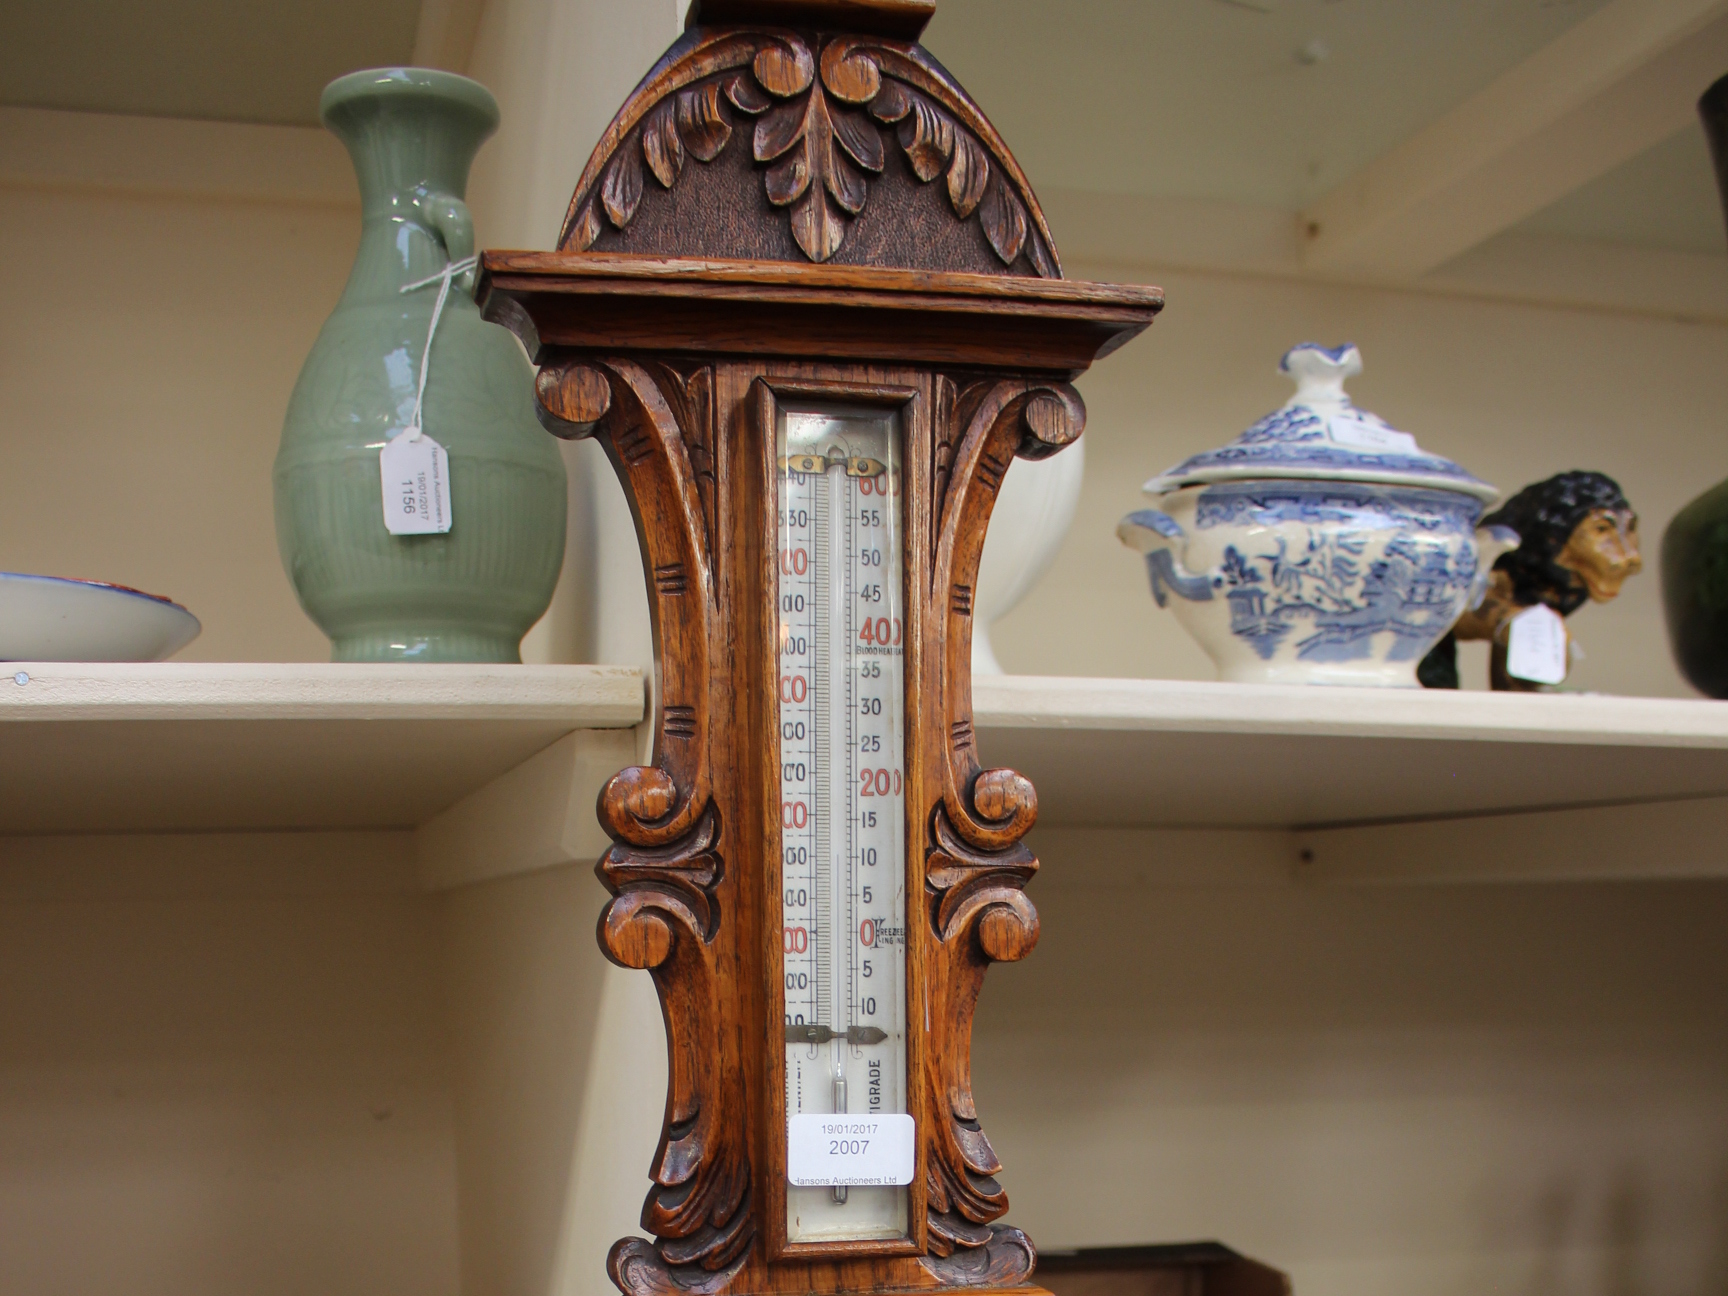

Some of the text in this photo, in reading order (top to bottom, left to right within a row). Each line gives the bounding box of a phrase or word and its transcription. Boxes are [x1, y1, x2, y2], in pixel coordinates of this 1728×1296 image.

[402, 479, 416, 514] 1156
[417, 472, 429, 521] 19/01/2017
[861, 509, 880, 527] 55
[861, 549, 880, 566] 50
[861, 584, 881, 602] 45
[859, 616, 891, 646] 40
[861, 660, 881, 678] 35
[861, 698, 881, 715] 30
[861, 735, 880, 752] 25
[860, 768, 891, 797] 20
[861, 811, 877, 828] 15
[861, 848, 877, 866] 10
[862, 886, 872, 904] 5
[860, 918, 874, 946] 0
[862, 961, 872, 977] 5
[861, 997, 876, 1015] 10
[869, 1060, 880, 1114] IGRADE
[822, 1125, 878, 1135] 19/01/2017
[829, 1140, 870, 1155] 2007
[832, 1177, 882, 1185] Auctioneers
[884, 1176, 897, 1184] Ltd
